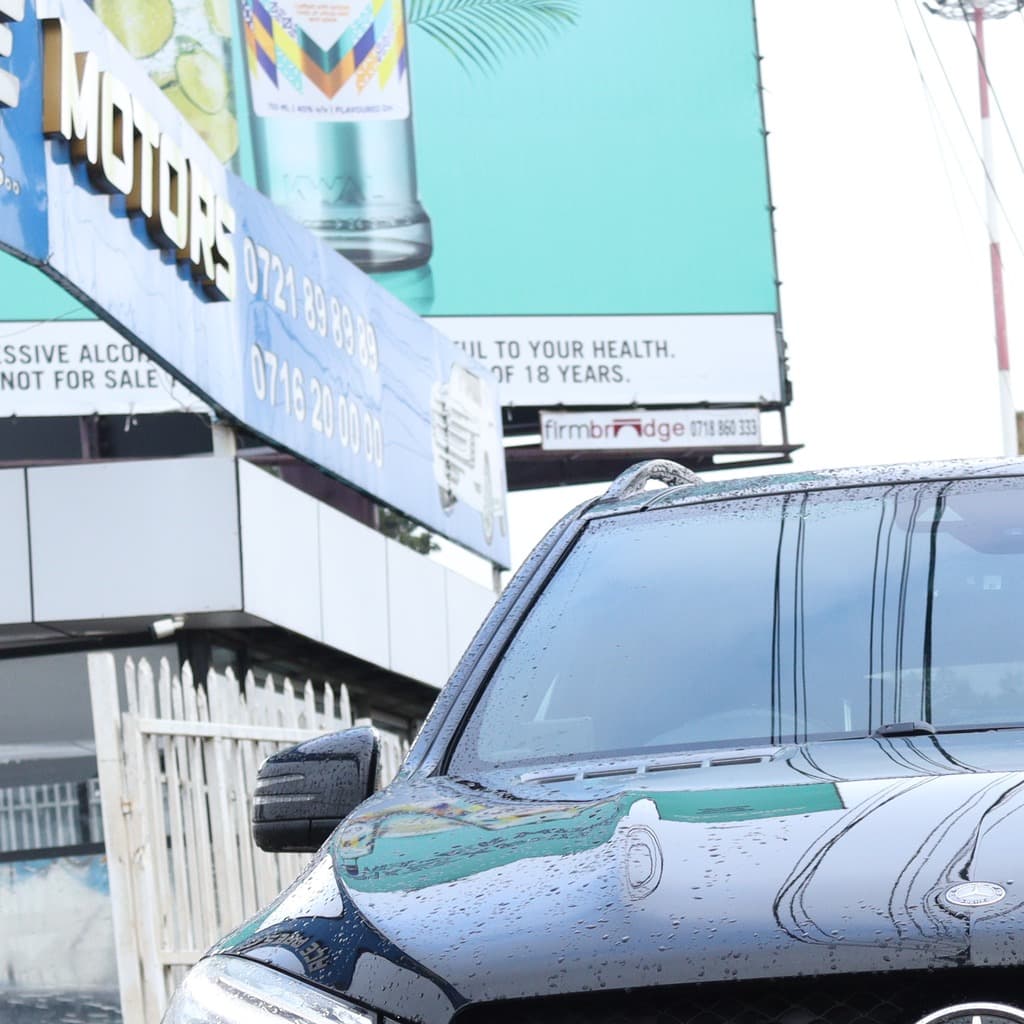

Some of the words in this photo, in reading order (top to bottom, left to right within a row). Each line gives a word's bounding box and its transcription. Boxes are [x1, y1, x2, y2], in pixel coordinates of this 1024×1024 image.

[44, 17, 236, 302] MOTORS
[243, 236, 298, 320] 0721
[303, 274, 328, 338] 89
[331, 296, 355, 356] 89
[0, 344, 70, 364] SSIVE
[495, 340, 521, 359] TO
[529, 340, 584, 358] YOUR
[592, 339, 676, 359] HEALTH.
[0, 371, 44, 390] NOT
[54, 370, 95, 390] FOR
[105, 369, 158, 389] SALE
[525, 365, 550, 383] 18
[557, 364, 631, 383] YEARS.
[251, 342, 307, 422] 0716
[310, 376, 334, 439] 20
[338, 395, 361, 455] 00
[363, 411, 384, 468] 00
